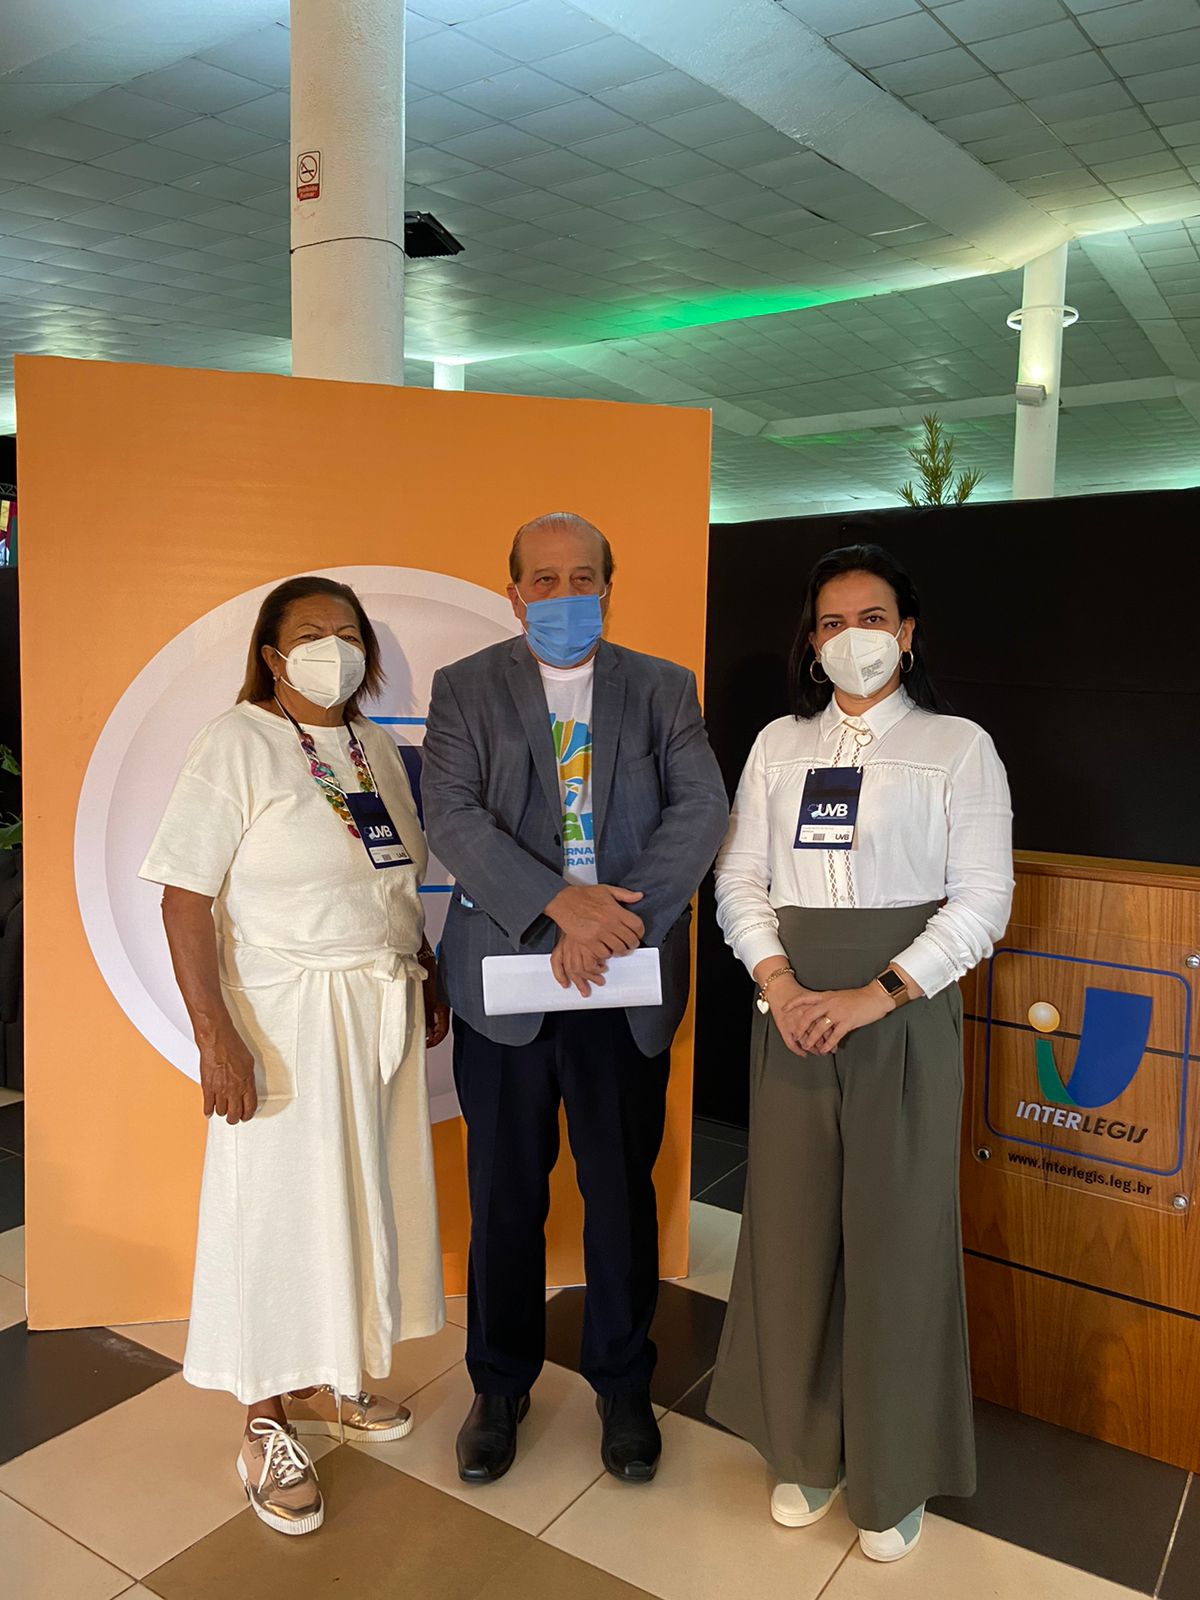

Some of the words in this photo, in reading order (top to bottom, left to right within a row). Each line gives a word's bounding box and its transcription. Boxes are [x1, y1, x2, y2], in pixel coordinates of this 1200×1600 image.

[817, 803, 848, 816] UVB
[370, 825, 392, 837] UVB
[564, 847, 593, 856] RNA
[564, 858, 594, 866] RAN
[1016, 1100, 1149, 1144] INTERLEGIS
[1007, 1152, 1153, 1195] www.interlegis.leg.br
